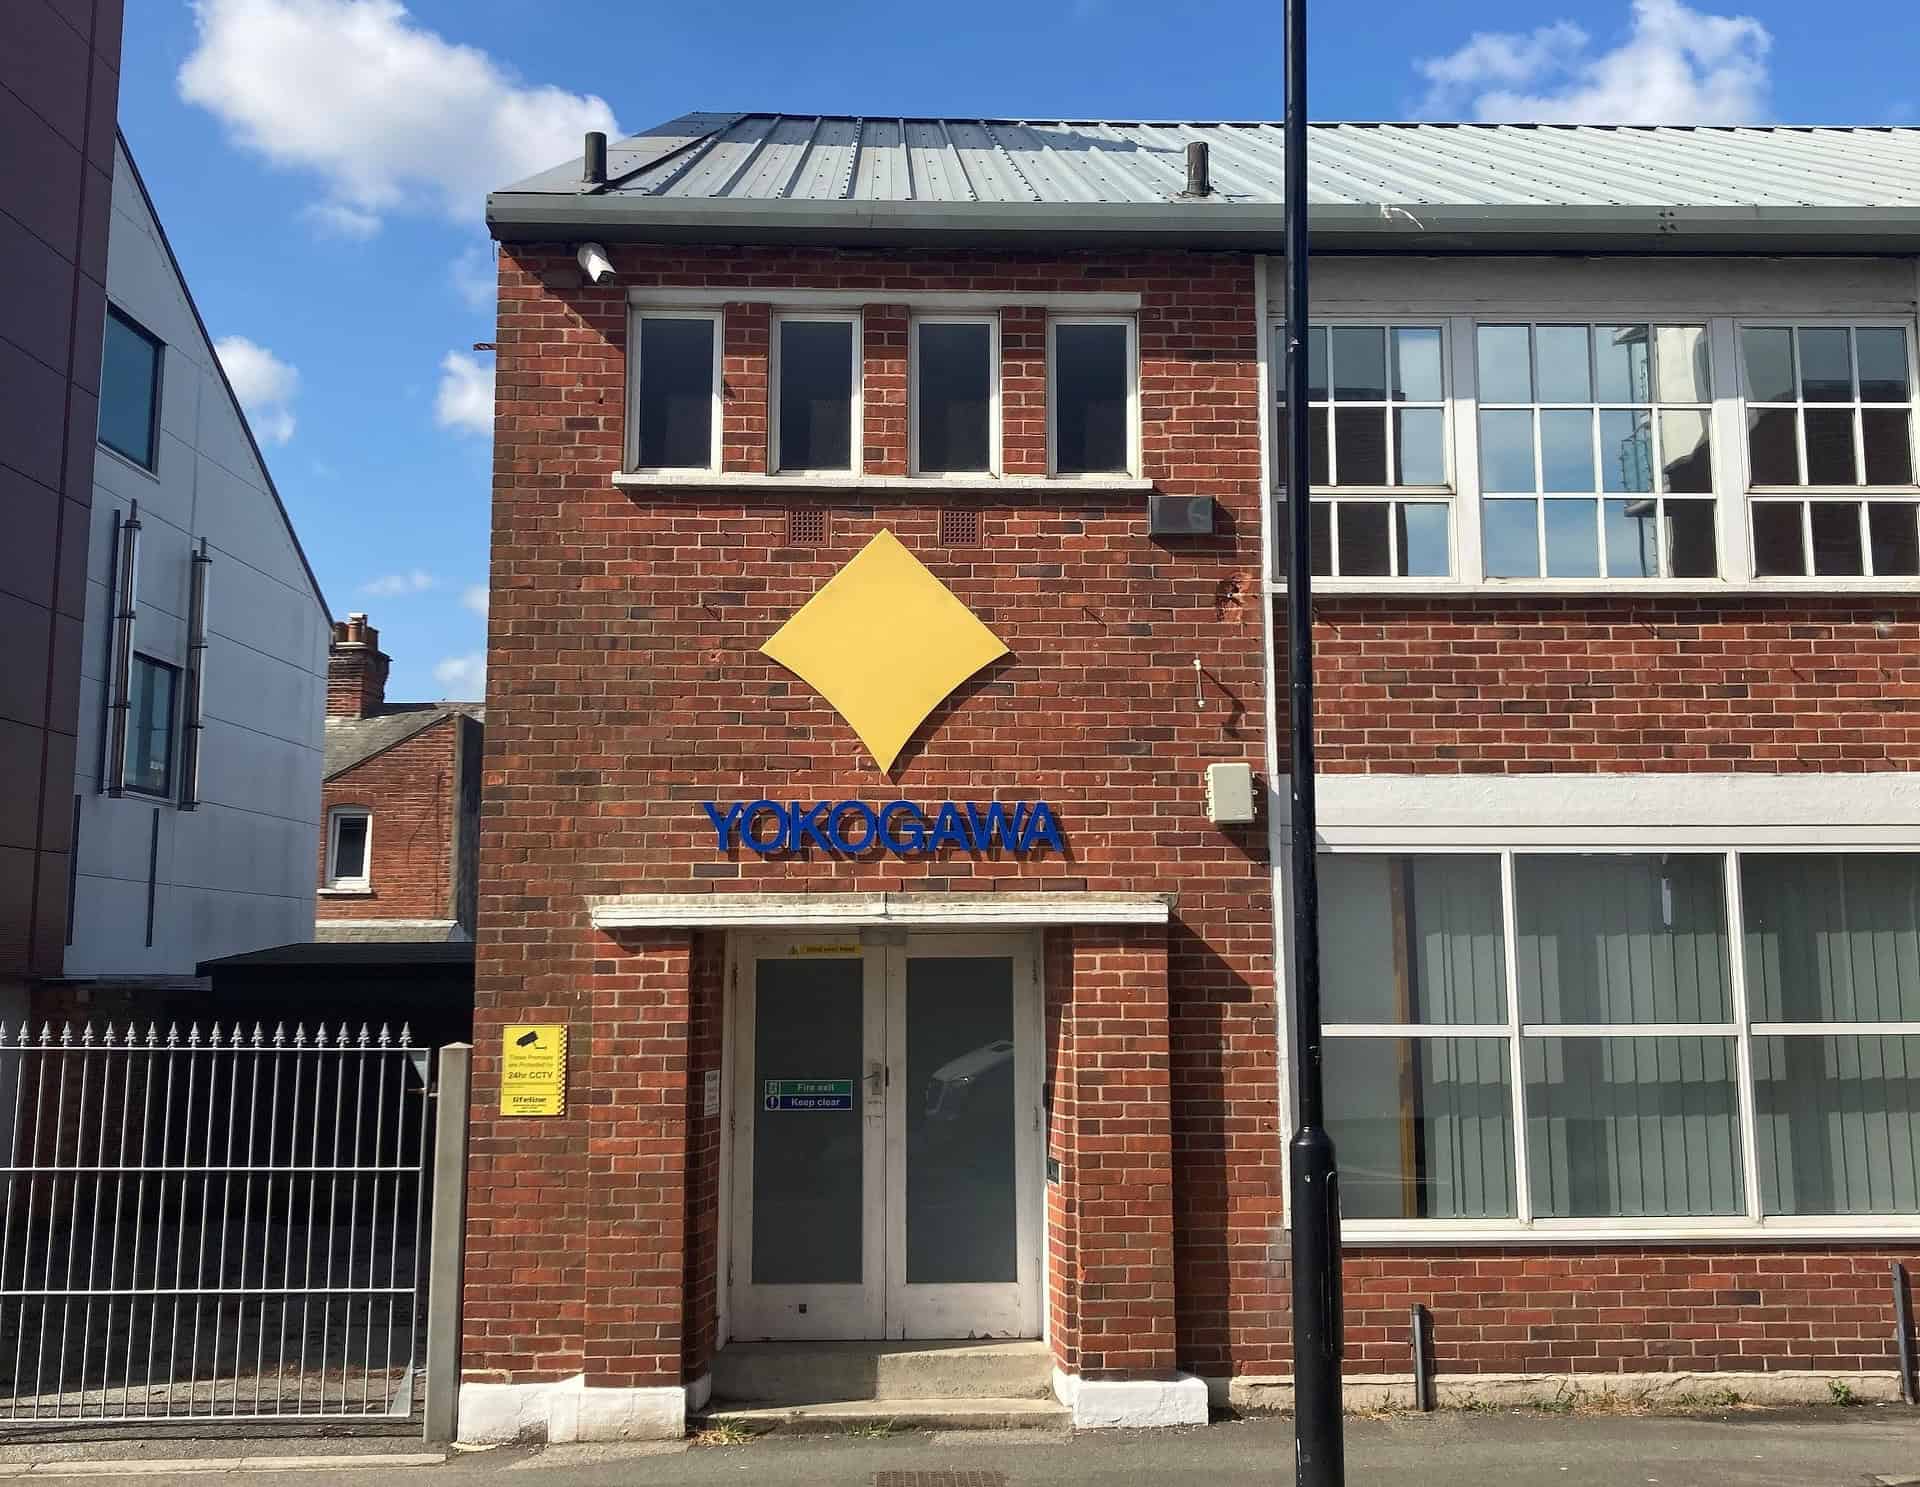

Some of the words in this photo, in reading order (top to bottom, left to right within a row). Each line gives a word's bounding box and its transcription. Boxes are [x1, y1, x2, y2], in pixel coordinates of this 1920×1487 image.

[703, 799, 1064, 852] YOKOGAWA
[507, 1071, 527, 1079] 24hr
[529, 1071, 553, 1079] CCTV
[797, 1083, 815, 1093] Fire
[817, 1083, 835, 1093] exit
[791, 1097, 815, 1108] Keep
[817, 1097, 841, 1106] clear
